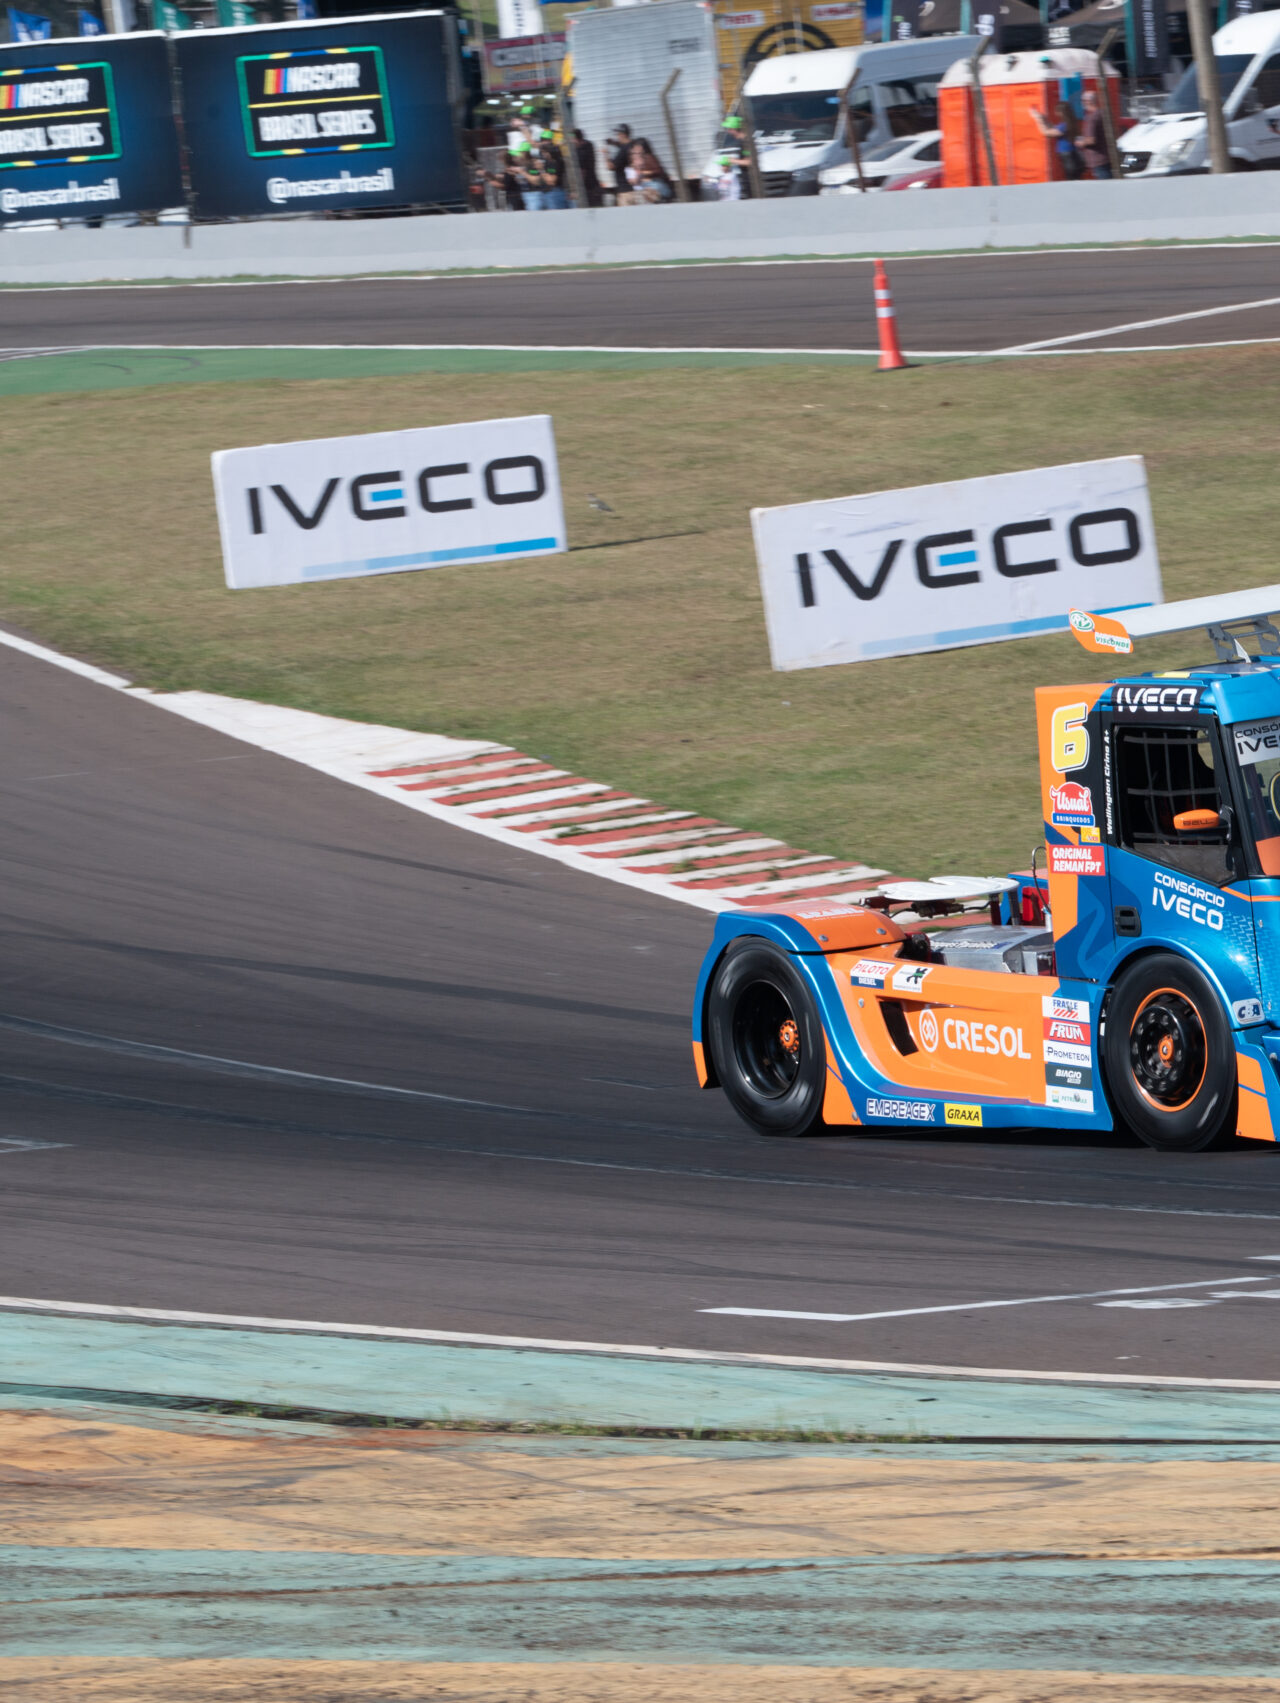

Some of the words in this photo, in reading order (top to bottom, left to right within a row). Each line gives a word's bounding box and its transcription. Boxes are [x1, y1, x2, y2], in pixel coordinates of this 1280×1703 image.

[285, 63, 360, 93] NASCAR
[246, 455, 546, 535] IVECO
[796, 507, 1141, 608] IVECO
[1095, 636, 1130, 649] VISCONDE
[1116, 687, 1198, 713] IVECO
[1051, 702, 1090, 774] 6
[1051, 787, 1090, 812] Usual
[1056, 815, 1091, 824] BRINQUEDOS
[1052, 847, 1093, 860] ORIGINAL
[1053, 860, 1085, 873] REMAN
[1084, 861, 1102, 874] FPT
[1154, 871, 1225, 908] CONSÓRCIO
[1152, 886, 1224, 931] IVECO
[853, 963, 889, 975] PILOTO
[943, 1018, 1031, 1060] CRESOL
[1049, 1021, 1085, 1041] FRUM
[1046, 1046, 1090, 1062] PROMETEON
[1055, 1068, 1082, 1079] BIAGIO
[867, 1098, 935, 1121] EMBREAGEX
[947, 1108, 980, 1122] GRAXA
